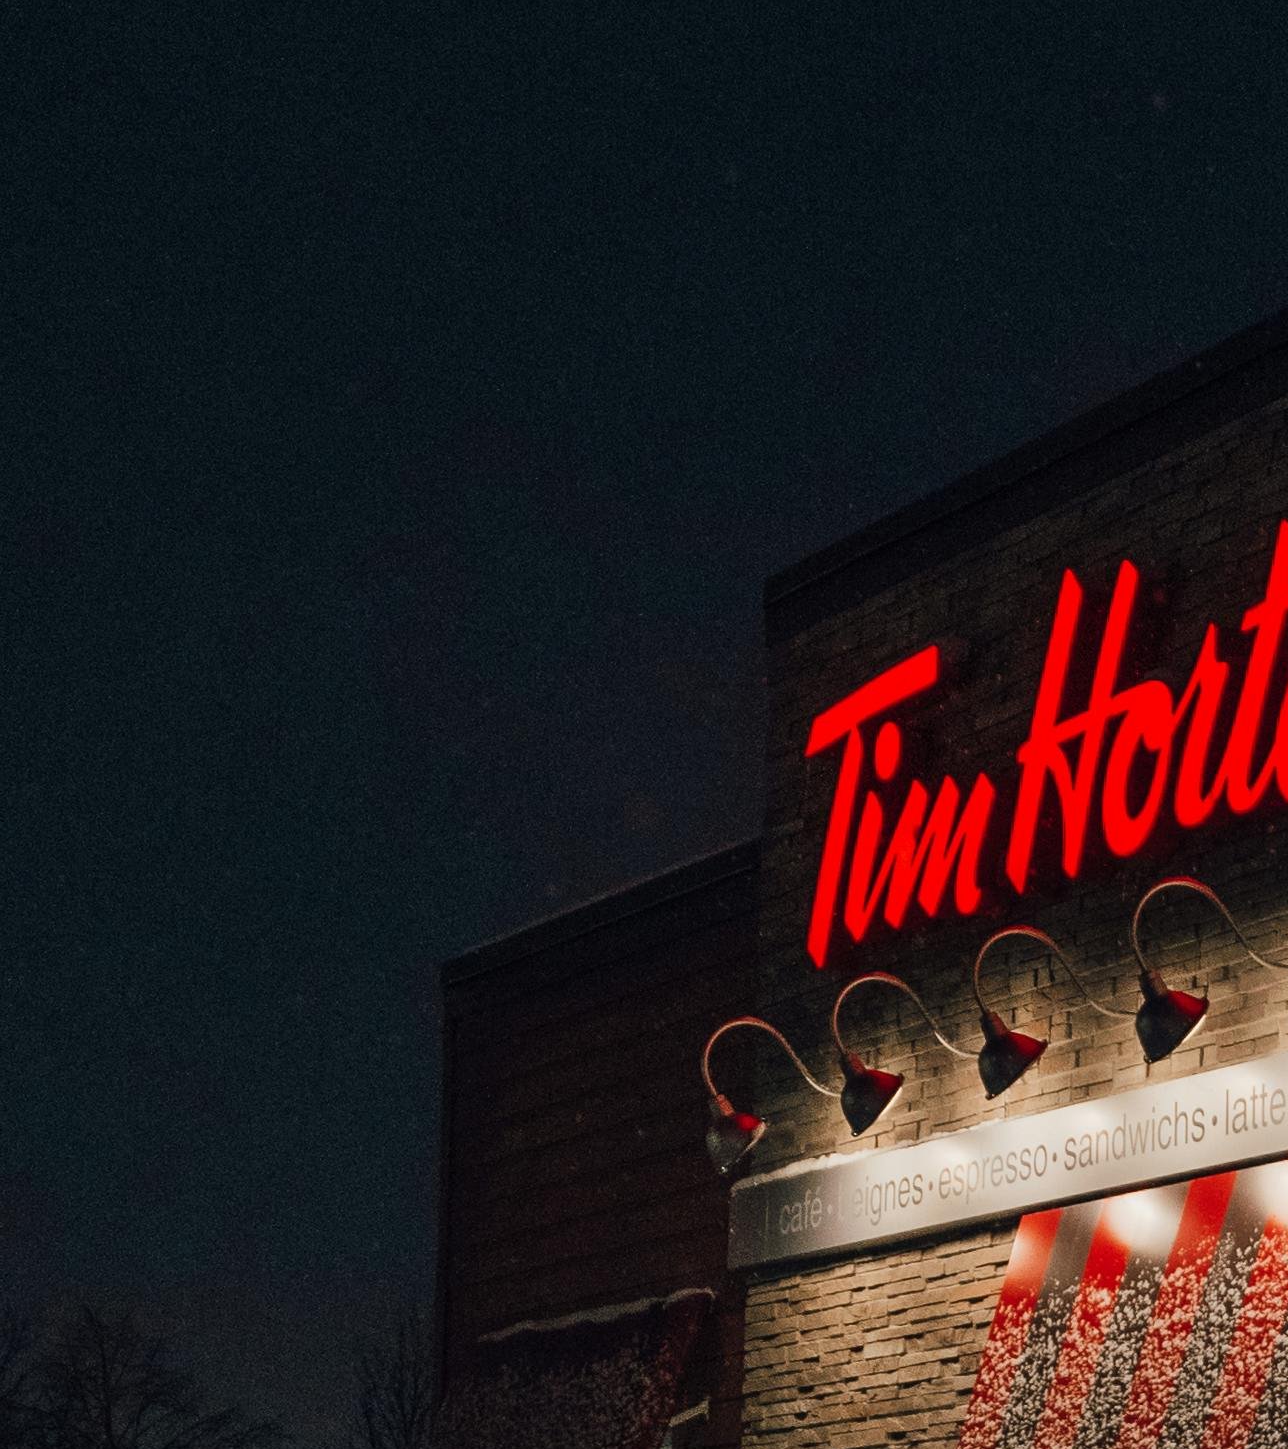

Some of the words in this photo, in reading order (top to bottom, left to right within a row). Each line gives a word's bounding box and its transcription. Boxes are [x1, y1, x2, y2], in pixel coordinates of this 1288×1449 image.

[806, 645, 995, 968] Tim
[779, 1186, 823, 1235] café
[938, 1144, 1048, 1205] espresso
[1062, 1101, 1206, 1172] sandwichs
[1224, 1081, 1287, 1135] latte
